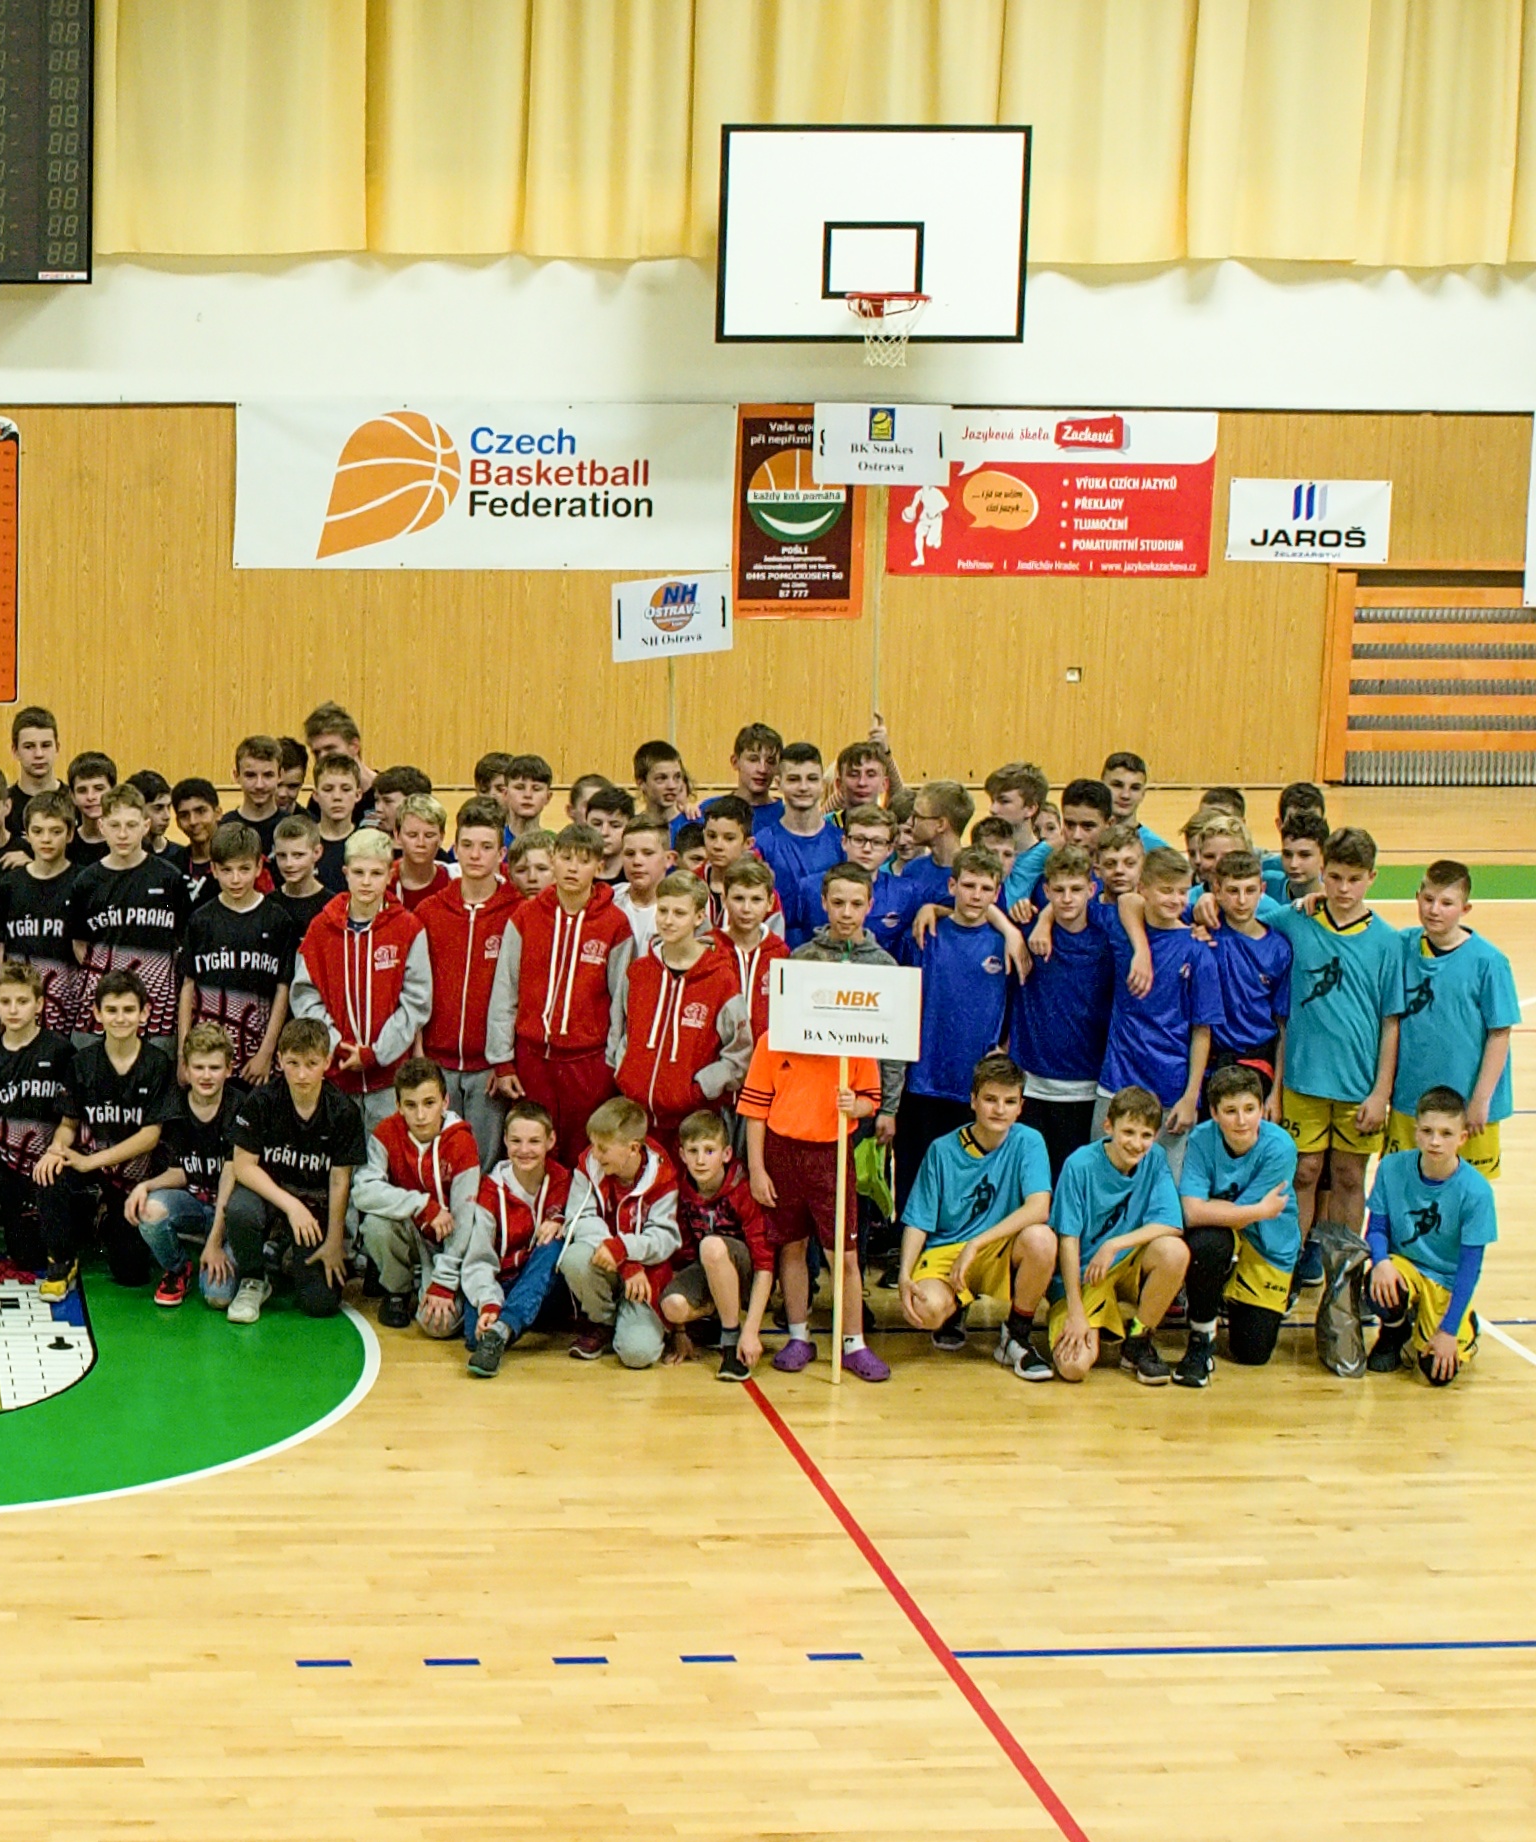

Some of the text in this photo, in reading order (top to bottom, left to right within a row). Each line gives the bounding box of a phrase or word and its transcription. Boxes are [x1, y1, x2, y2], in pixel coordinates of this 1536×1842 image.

[470, 427, 576, 455] Czech
[962, 425, 1014, 443] Jazyková
[1020, 426, 1049, 441] škola
[850, 443, 914, 455] BK Snakes
[469, 458, 649, 486] Basketball
[858, 461, 904, 472] Ostrava
[1076, 476, 1177, 489] VÝUKA CIZÍCH JAZYKŮ
[783, 491, 800, 500] koš
[1074, 497, 1124, 510] PŘEKLADY
[469, 490, 653, 518] Federation
[1073, 518, 1128, 531] TLUMOČENÍ
[1072, 537, 1184, 551] POMATURITNÍ STUDIUM
[1250, 526, 1366, 548] JAROŠ
[1054, 560, 1080, 571] Hradec
[663, 583, 698, 605] NH
[644, 603, 701, 620] OSTRAVA
[641, 634, 702, 647] NH Ostrava
[125, 906, 175, 930] PRAHA
[835, 990, 881, 1007] NBK
[803, 1029, 889, 1045] BA Nymburk
